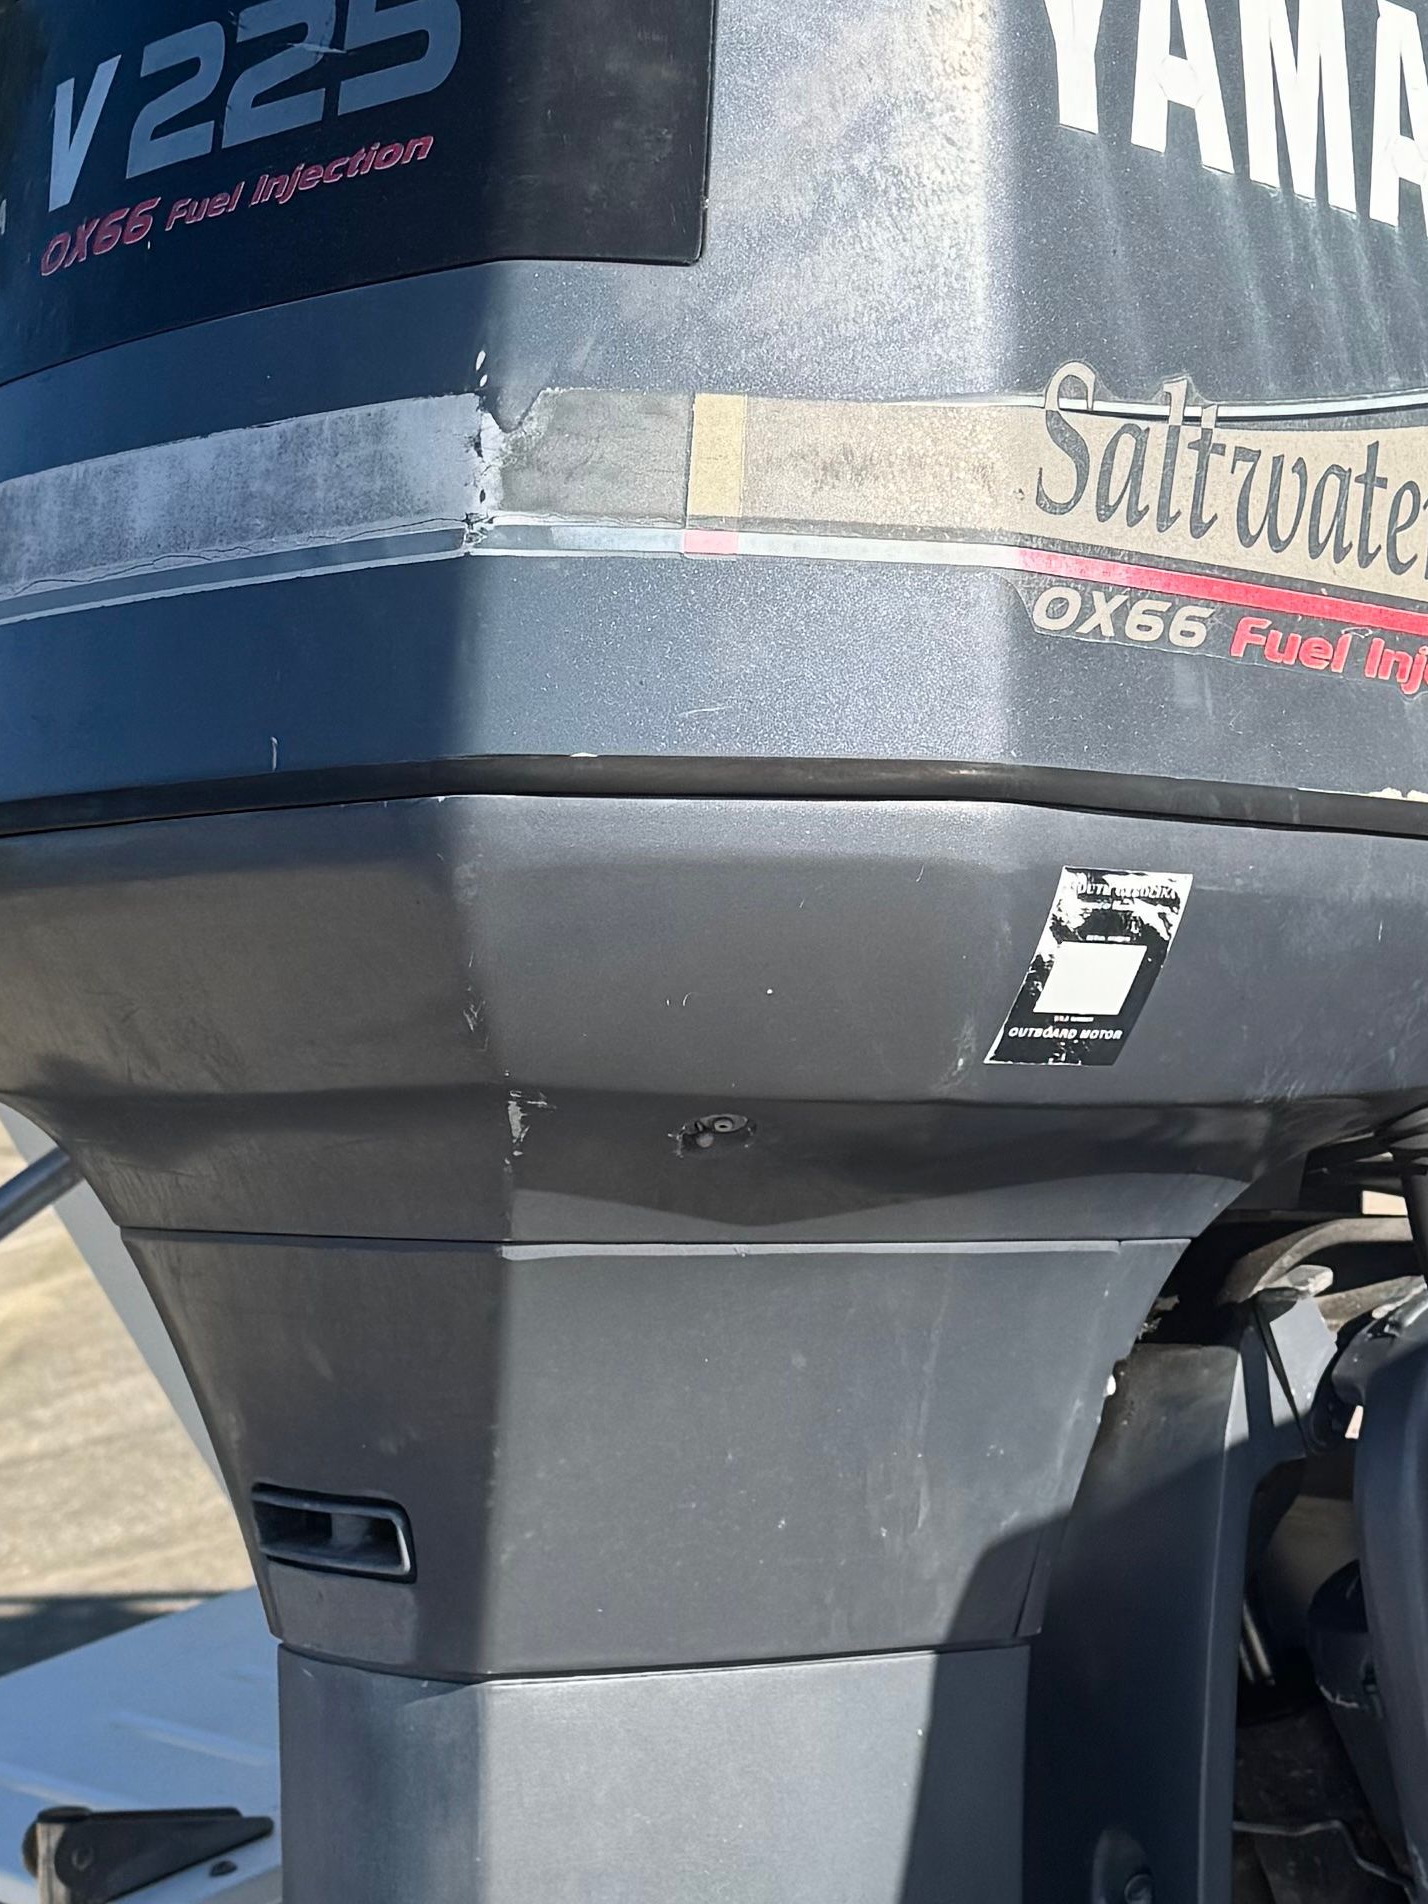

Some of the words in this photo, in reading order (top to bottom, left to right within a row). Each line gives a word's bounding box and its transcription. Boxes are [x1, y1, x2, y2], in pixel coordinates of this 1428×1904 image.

[40, 196, 162, 277] OX66
[165, 181, 246, 232] Fuel
[249, 134, 434, 206] Injection
[1032, 586, 1216, 648] OX66
[1229, 616, 1354, 674] Fuel
[1008, 1026, 1078, 1040] OUTBOARD
[1079, 1029, 1123, 1040] MOTOR
